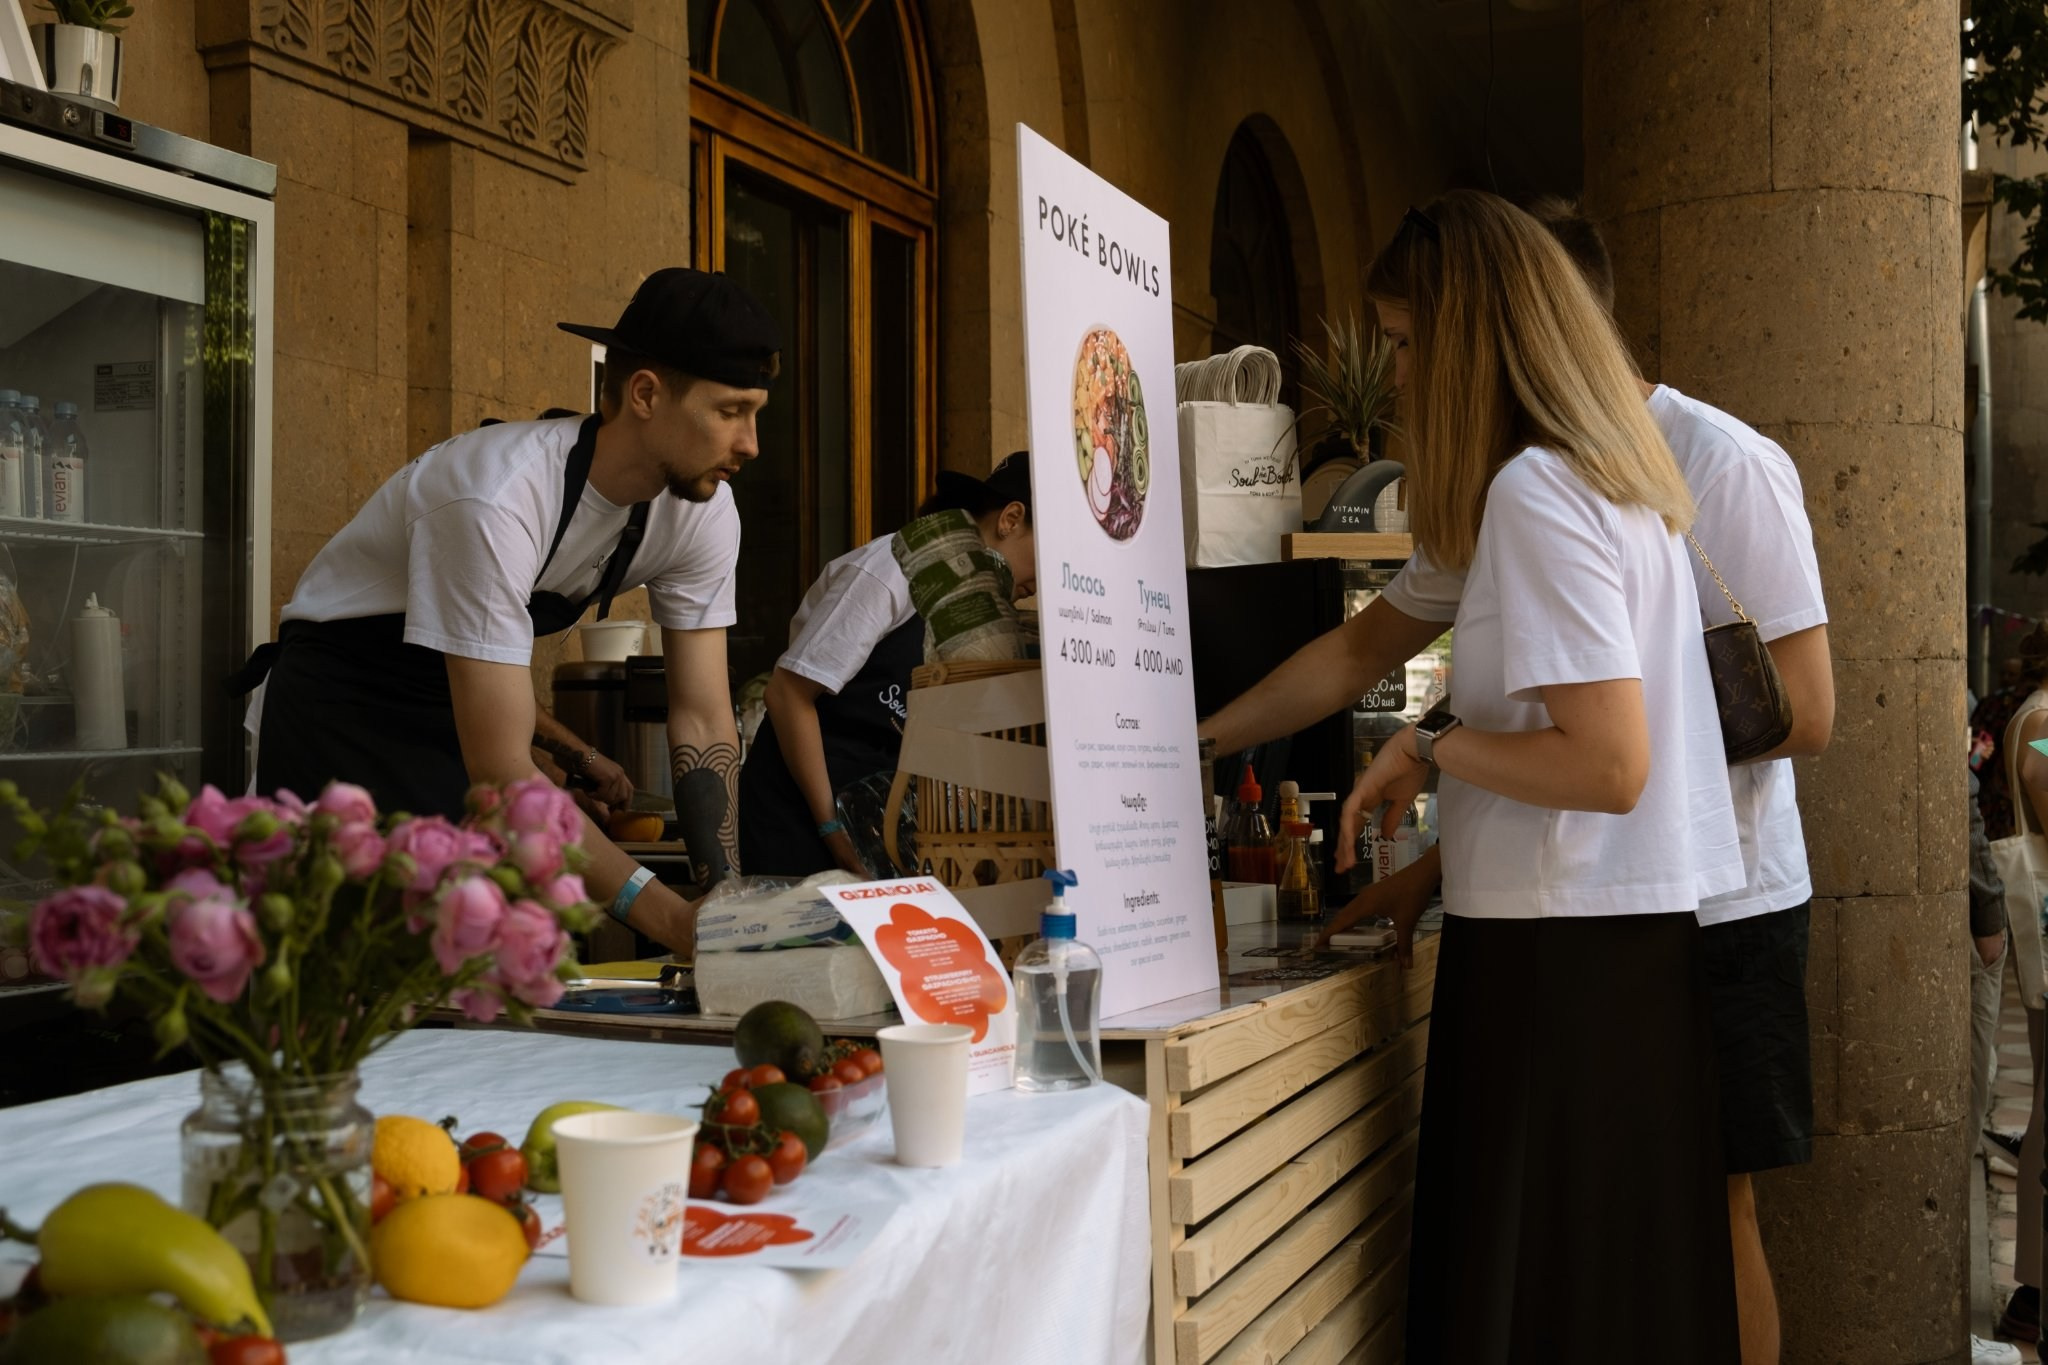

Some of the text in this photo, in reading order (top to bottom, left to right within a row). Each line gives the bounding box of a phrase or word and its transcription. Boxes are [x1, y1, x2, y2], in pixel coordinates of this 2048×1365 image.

[1038, 195, 1160, 298] POKÉ BOWLS
[54, 471, 67, 513] evian
[1332, 505, 1370, 515] VITAMIN
[1341, 515, 1360, 524] SEA
[1062, 562, 1106, 597] Лосось
[1137, 579, 1171, 614] Тунец
[1091, 608, 1113, 626] Salmon
[1162, 621, 1175, 636] Tuna
[1070, 638, 1092, 664] 300
[1095, 649, 1116, 668] AMD
[1143, 649, 1163, 674] 000
[1165, 658, 1183, 676] AMD
[1389, 683, 1404, 692] AMD
[1361, 694, 1396, 709] 130 RUB
[1378, 844, 1390, 880] vian
[1123, 889, 1161, 913] Ingredients:
